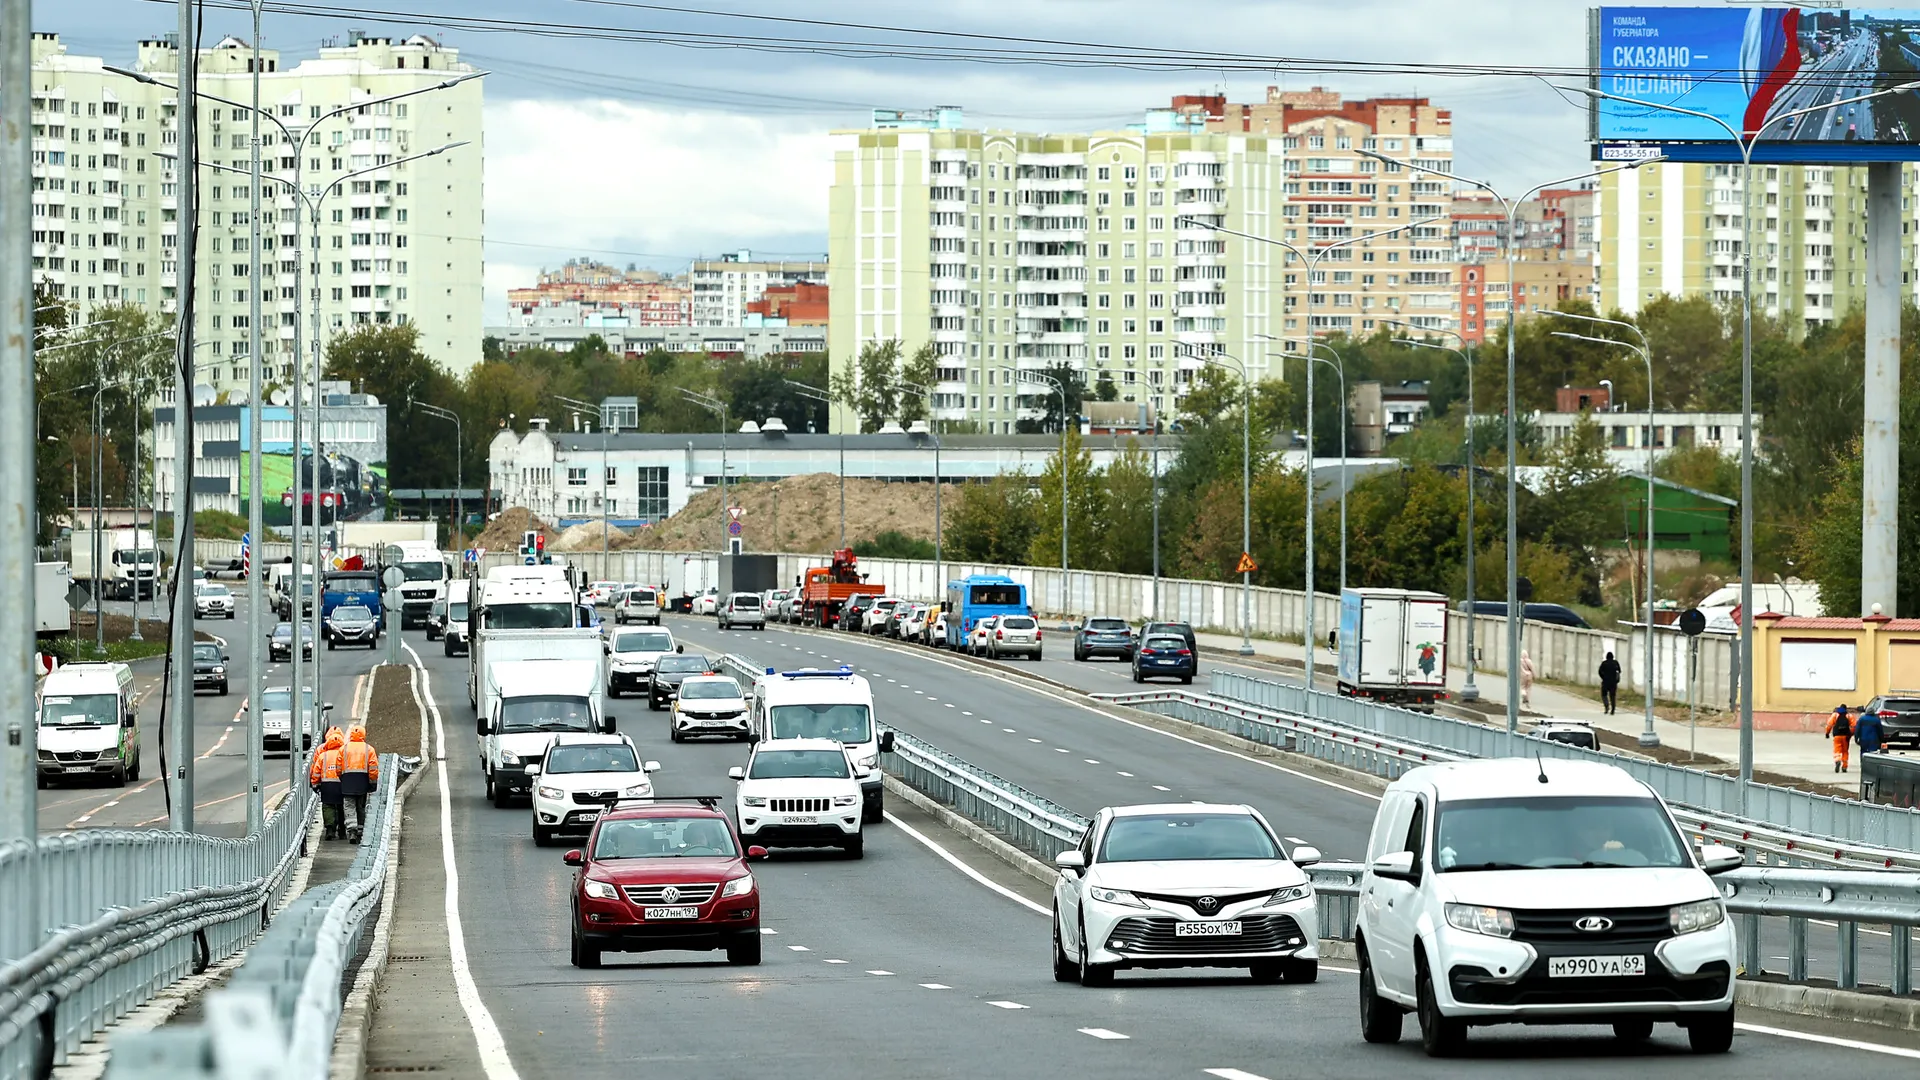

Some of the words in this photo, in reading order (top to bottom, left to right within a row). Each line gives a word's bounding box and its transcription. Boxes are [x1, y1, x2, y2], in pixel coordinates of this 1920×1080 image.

[1613, 16, 1646, 26] КОМАНДА
[1613, 28, 1659, 37] ГУБЕРНАТОРА
[1613, 46, 1689, 67] СКАЗАНО
[1613, 74, 1692, 96] СДЕЛАНО
[1604, 149, 1660, 158] 623-55-55.ru
[1555, 958, 1620, 975] М990УА
